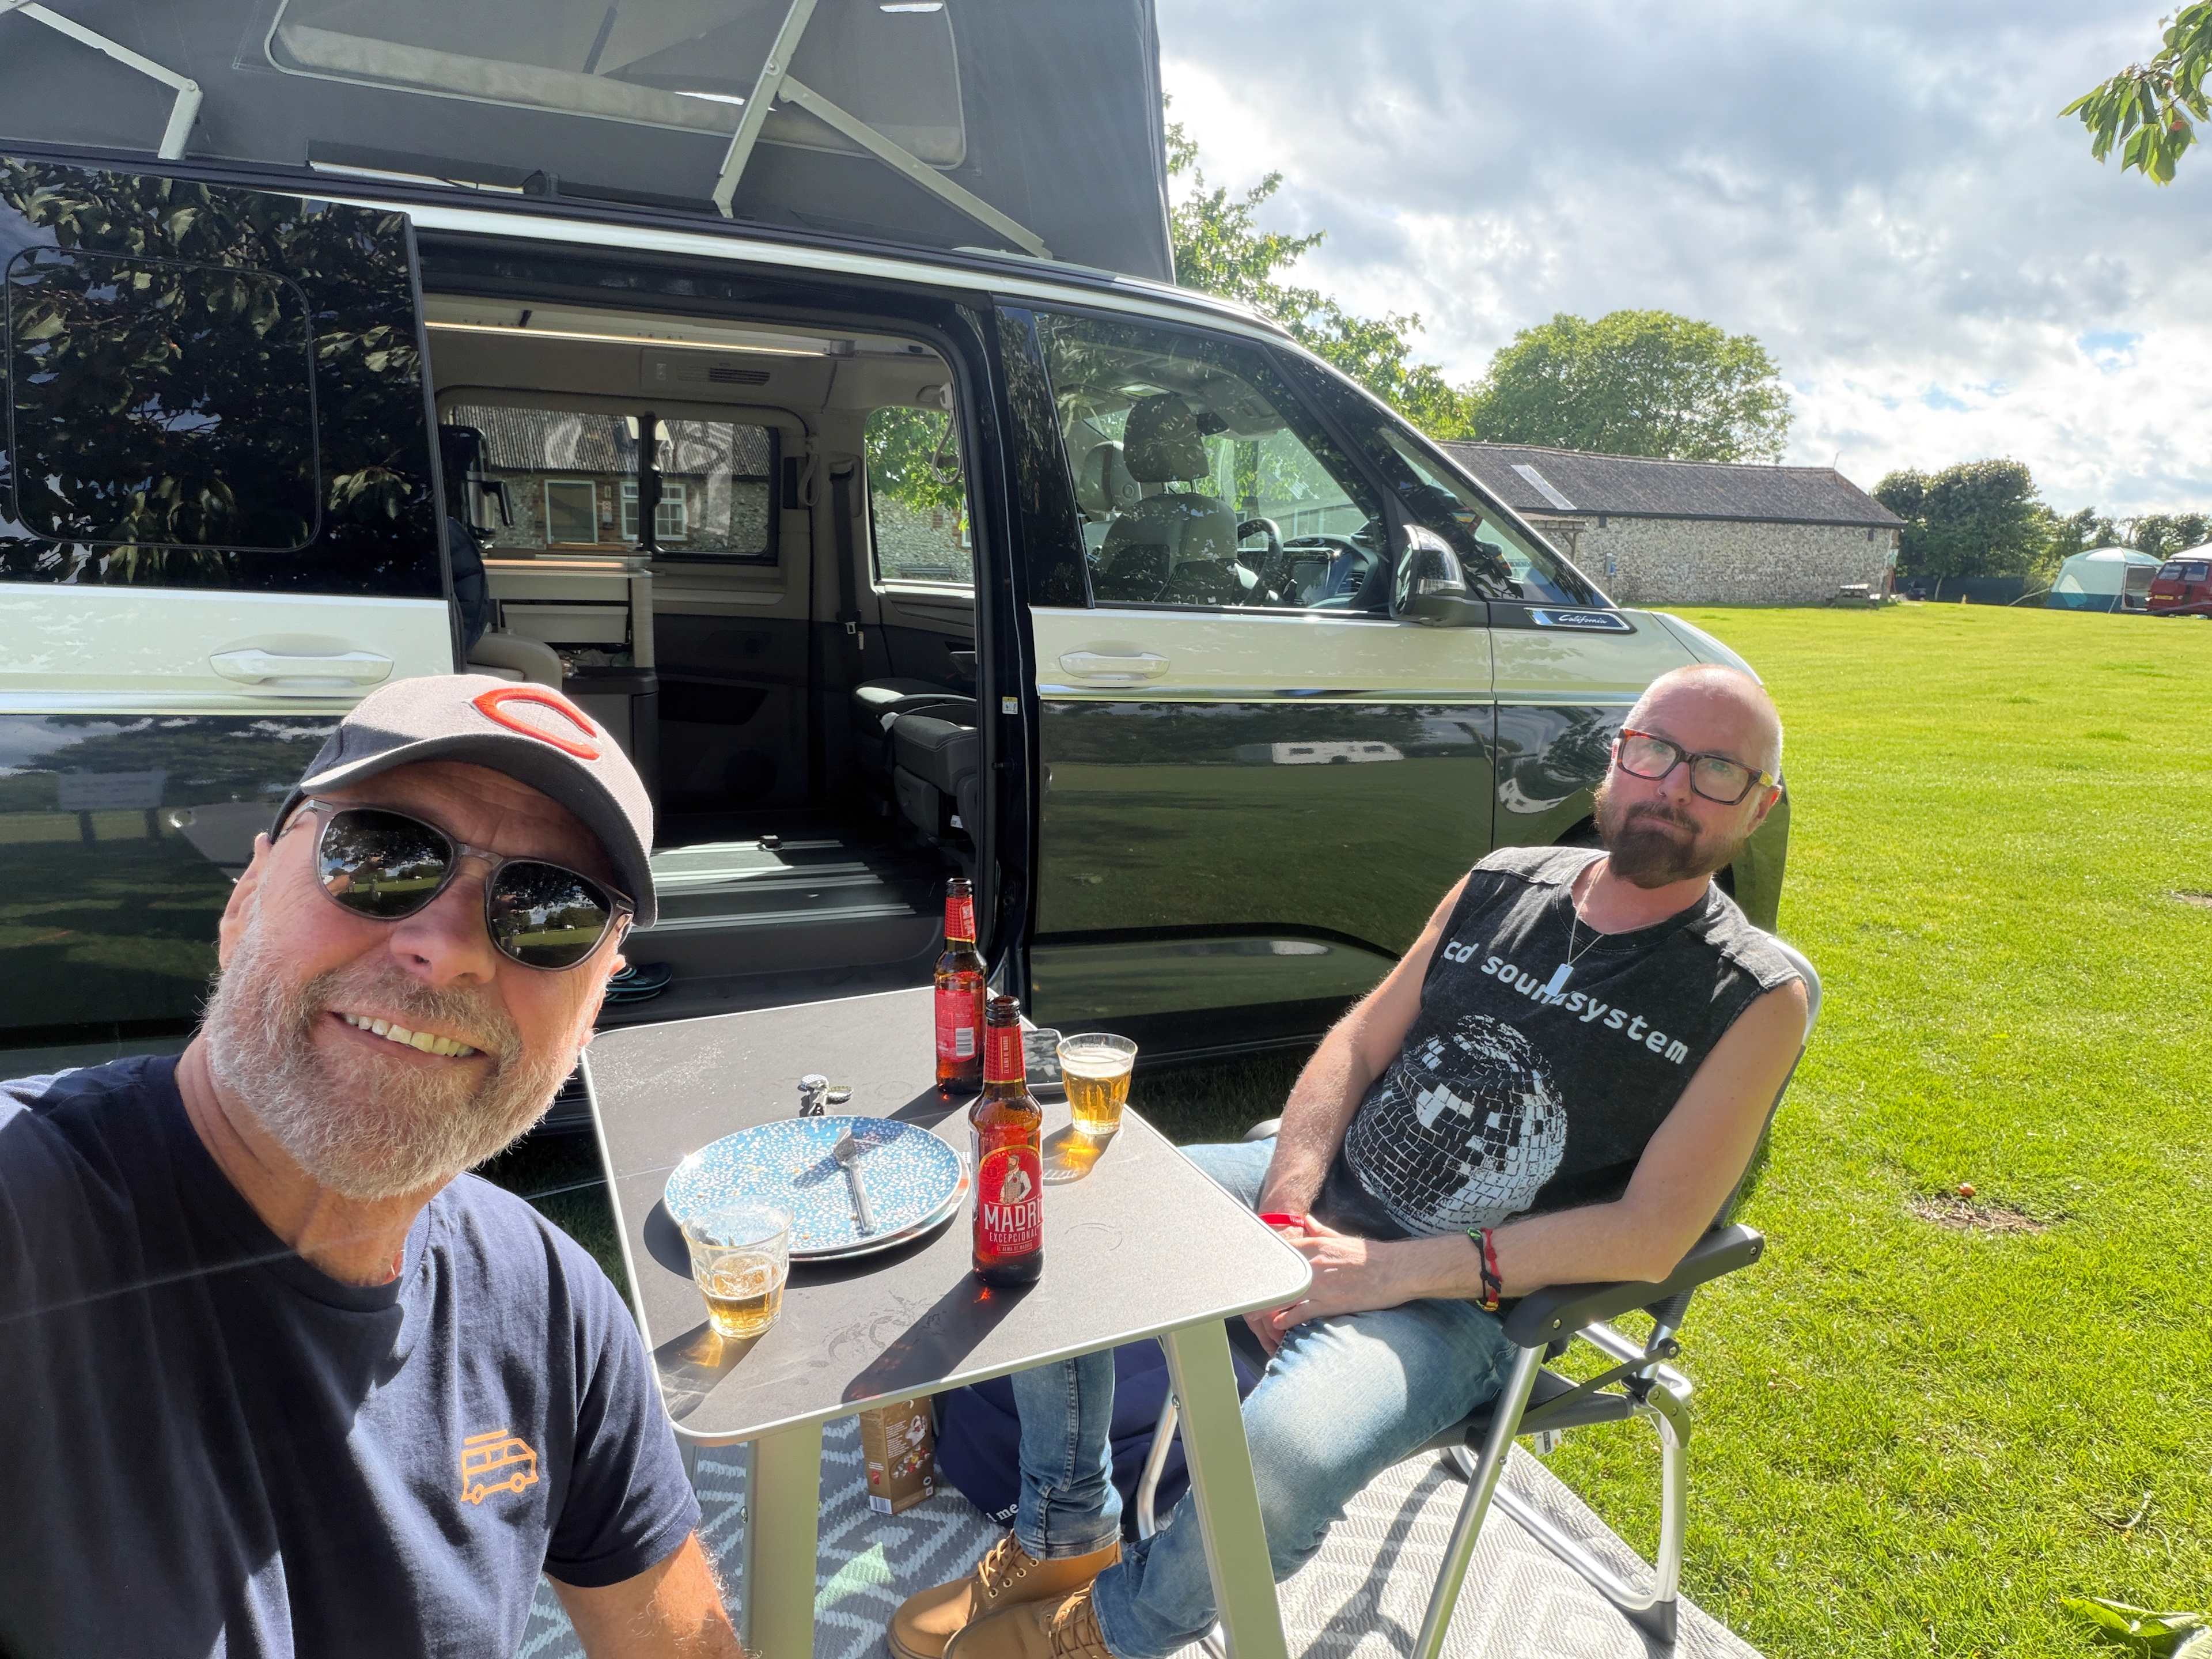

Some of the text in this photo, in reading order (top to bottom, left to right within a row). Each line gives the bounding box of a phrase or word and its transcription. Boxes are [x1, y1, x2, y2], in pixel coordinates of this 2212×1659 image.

[1558, 614, 1608, 624] California
[1440, 937, 1479, 964] cd
[990, 1230, 1037, 1243] EXCEPCIONAL
